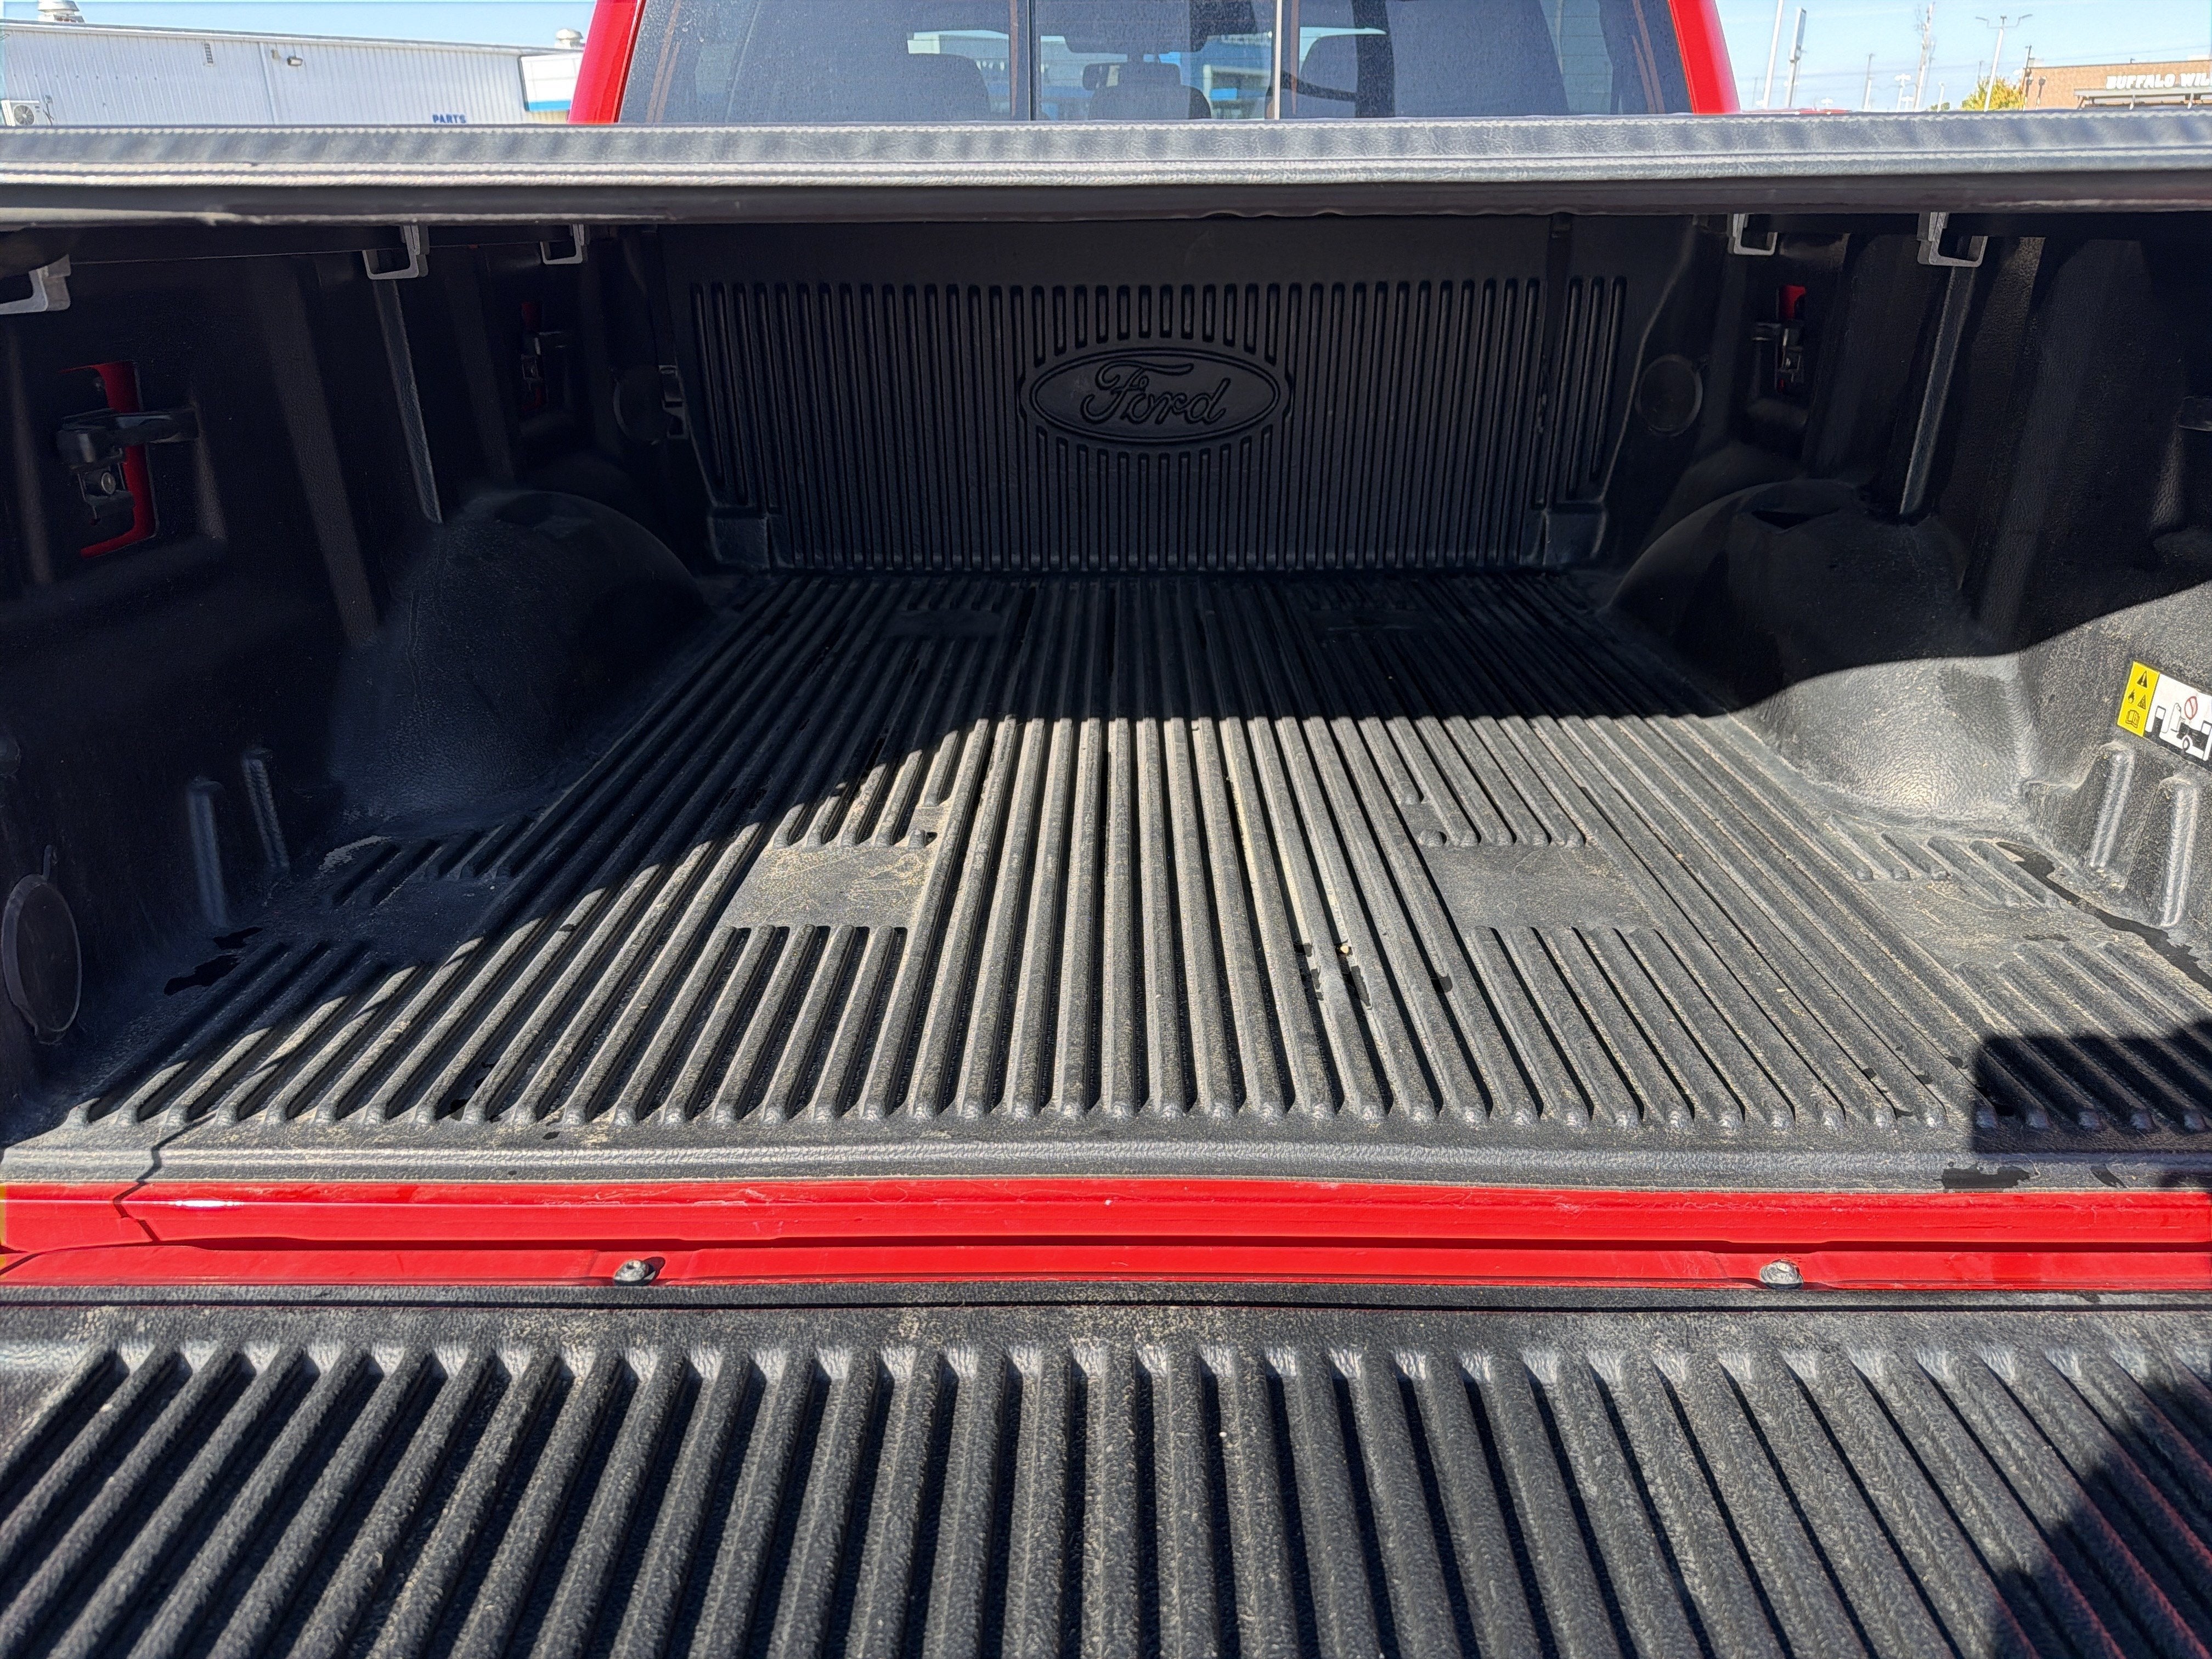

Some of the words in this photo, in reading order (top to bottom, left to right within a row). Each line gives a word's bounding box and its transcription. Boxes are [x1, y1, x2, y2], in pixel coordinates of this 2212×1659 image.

[2106, 74, 2176, 89] BUFFALO
[432, 114, 466, 123] PARTS
[1080, 359, 1232, 425] Ford
